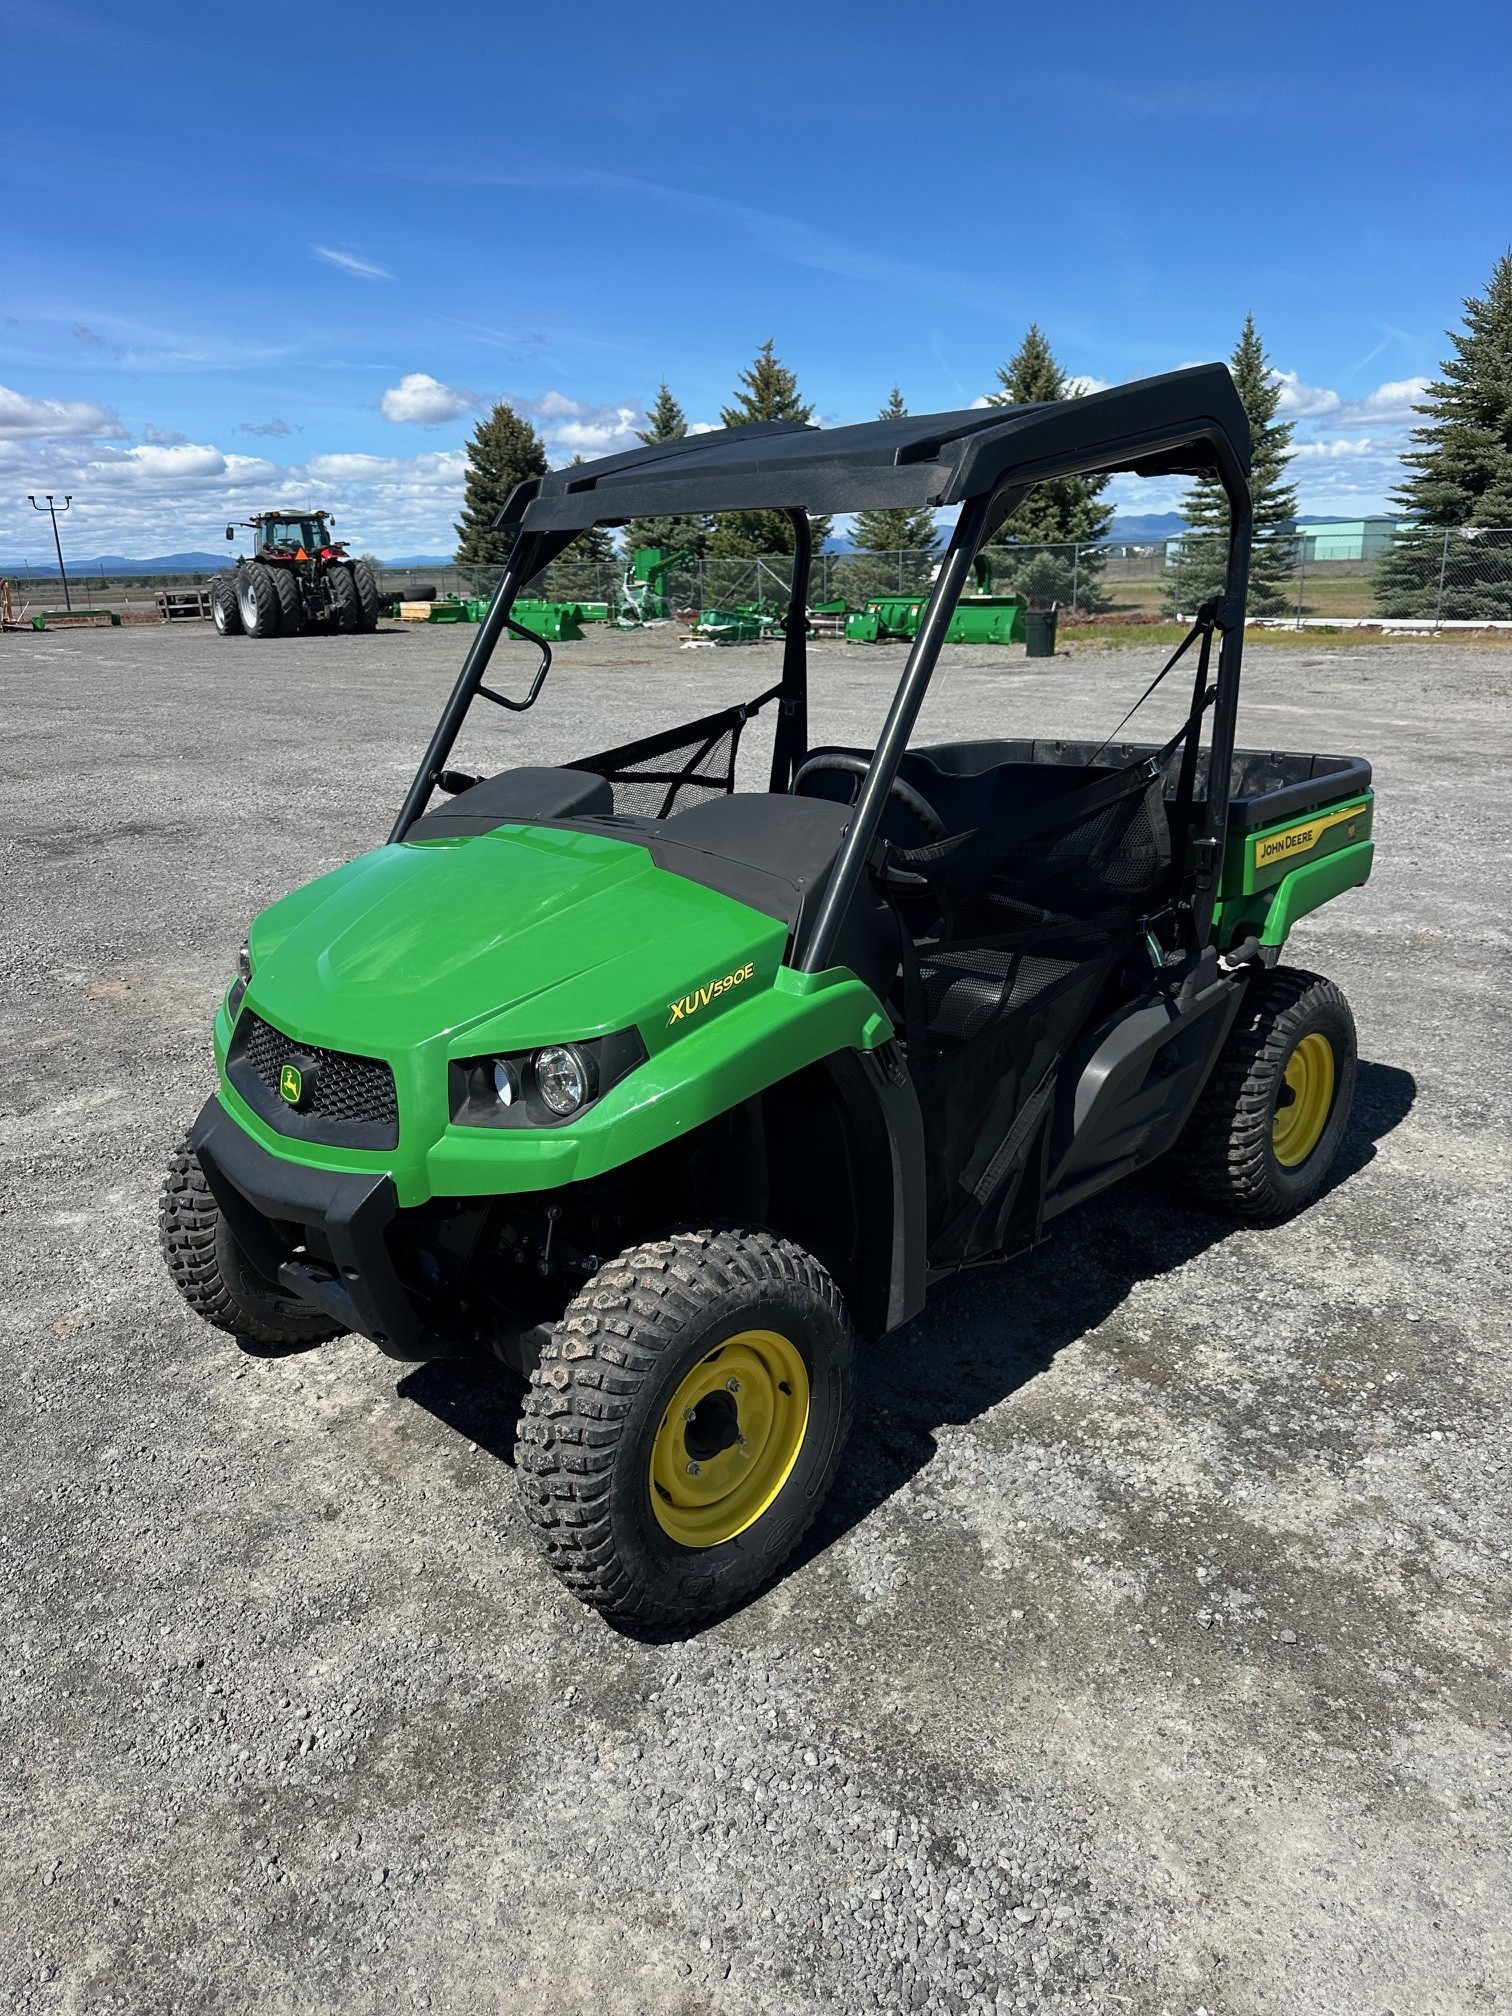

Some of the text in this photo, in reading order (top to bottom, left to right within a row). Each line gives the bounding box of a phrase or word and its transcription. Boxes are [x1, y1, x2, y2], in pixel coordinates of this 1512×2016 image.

[1261, 830, 1313, 858] JOHN DEERE
[669, 961, 754, 1025] XUV590E
